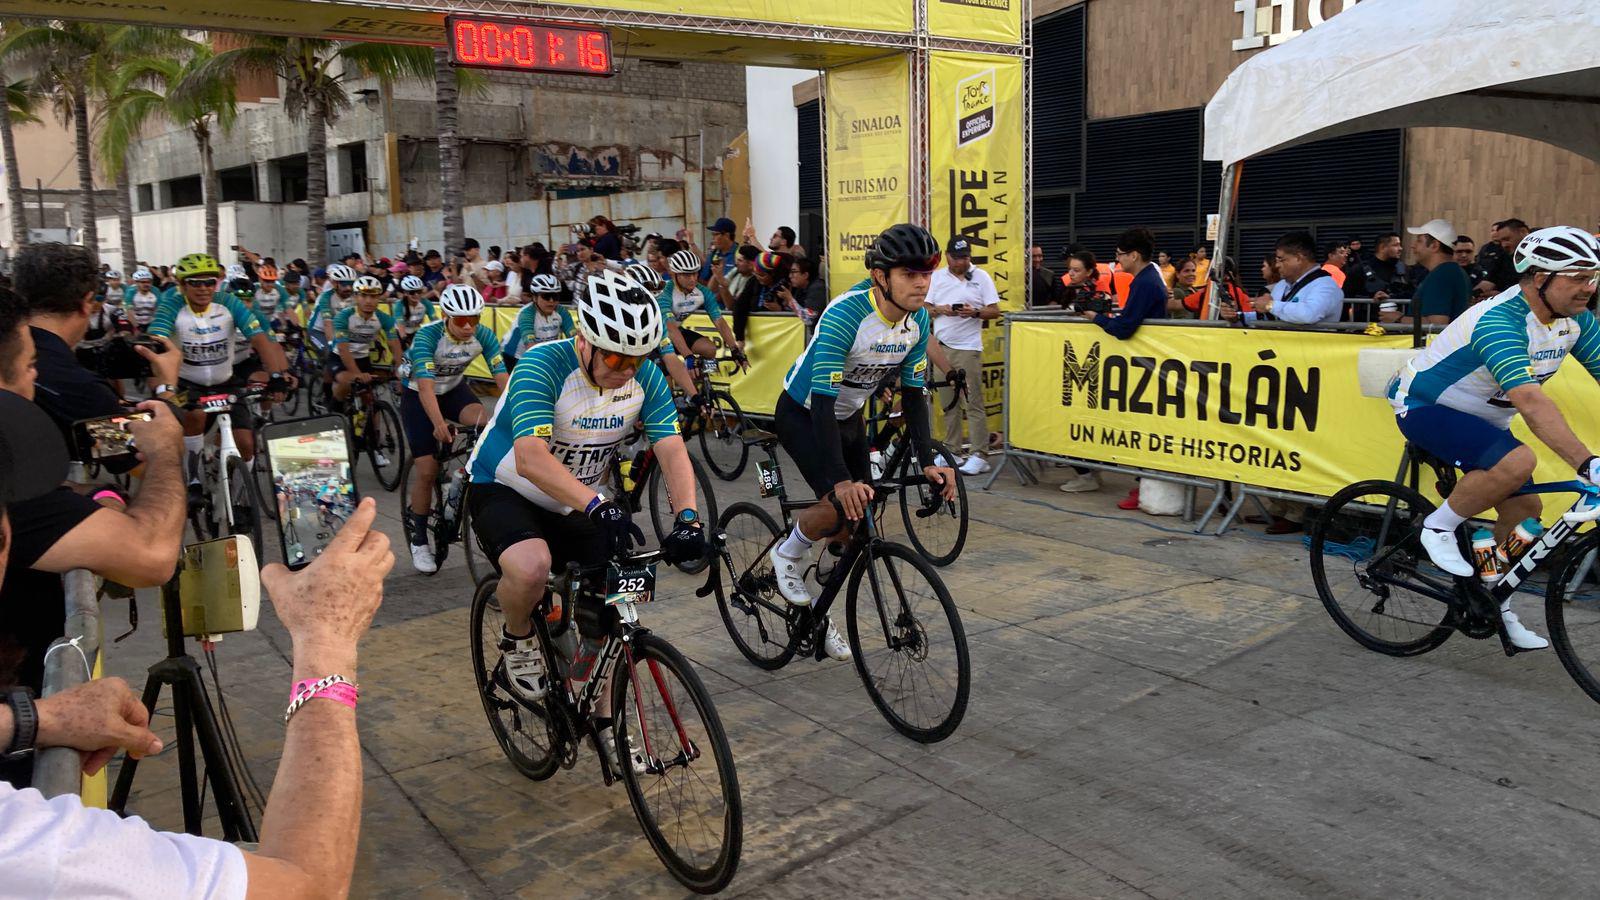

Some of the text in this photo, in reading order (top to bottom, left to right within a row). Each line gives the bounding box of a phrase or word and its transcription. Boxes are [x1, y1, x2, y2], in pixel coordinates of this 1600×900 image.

[455, 20, 608, 72] 00:01:16
[851, 115, 902, 133] SINALOA
[838, 176, 898, 194] TURISMO
[1062, 339, 1321, 432] MAZATLÁN
[1070, 423, 1302, 472] UN MAR DE HISTORIAS
[763, 469, 773, 490] 486
[1498, 494, 1595, 588] TREK
[617, 577, 646, 593] 252
